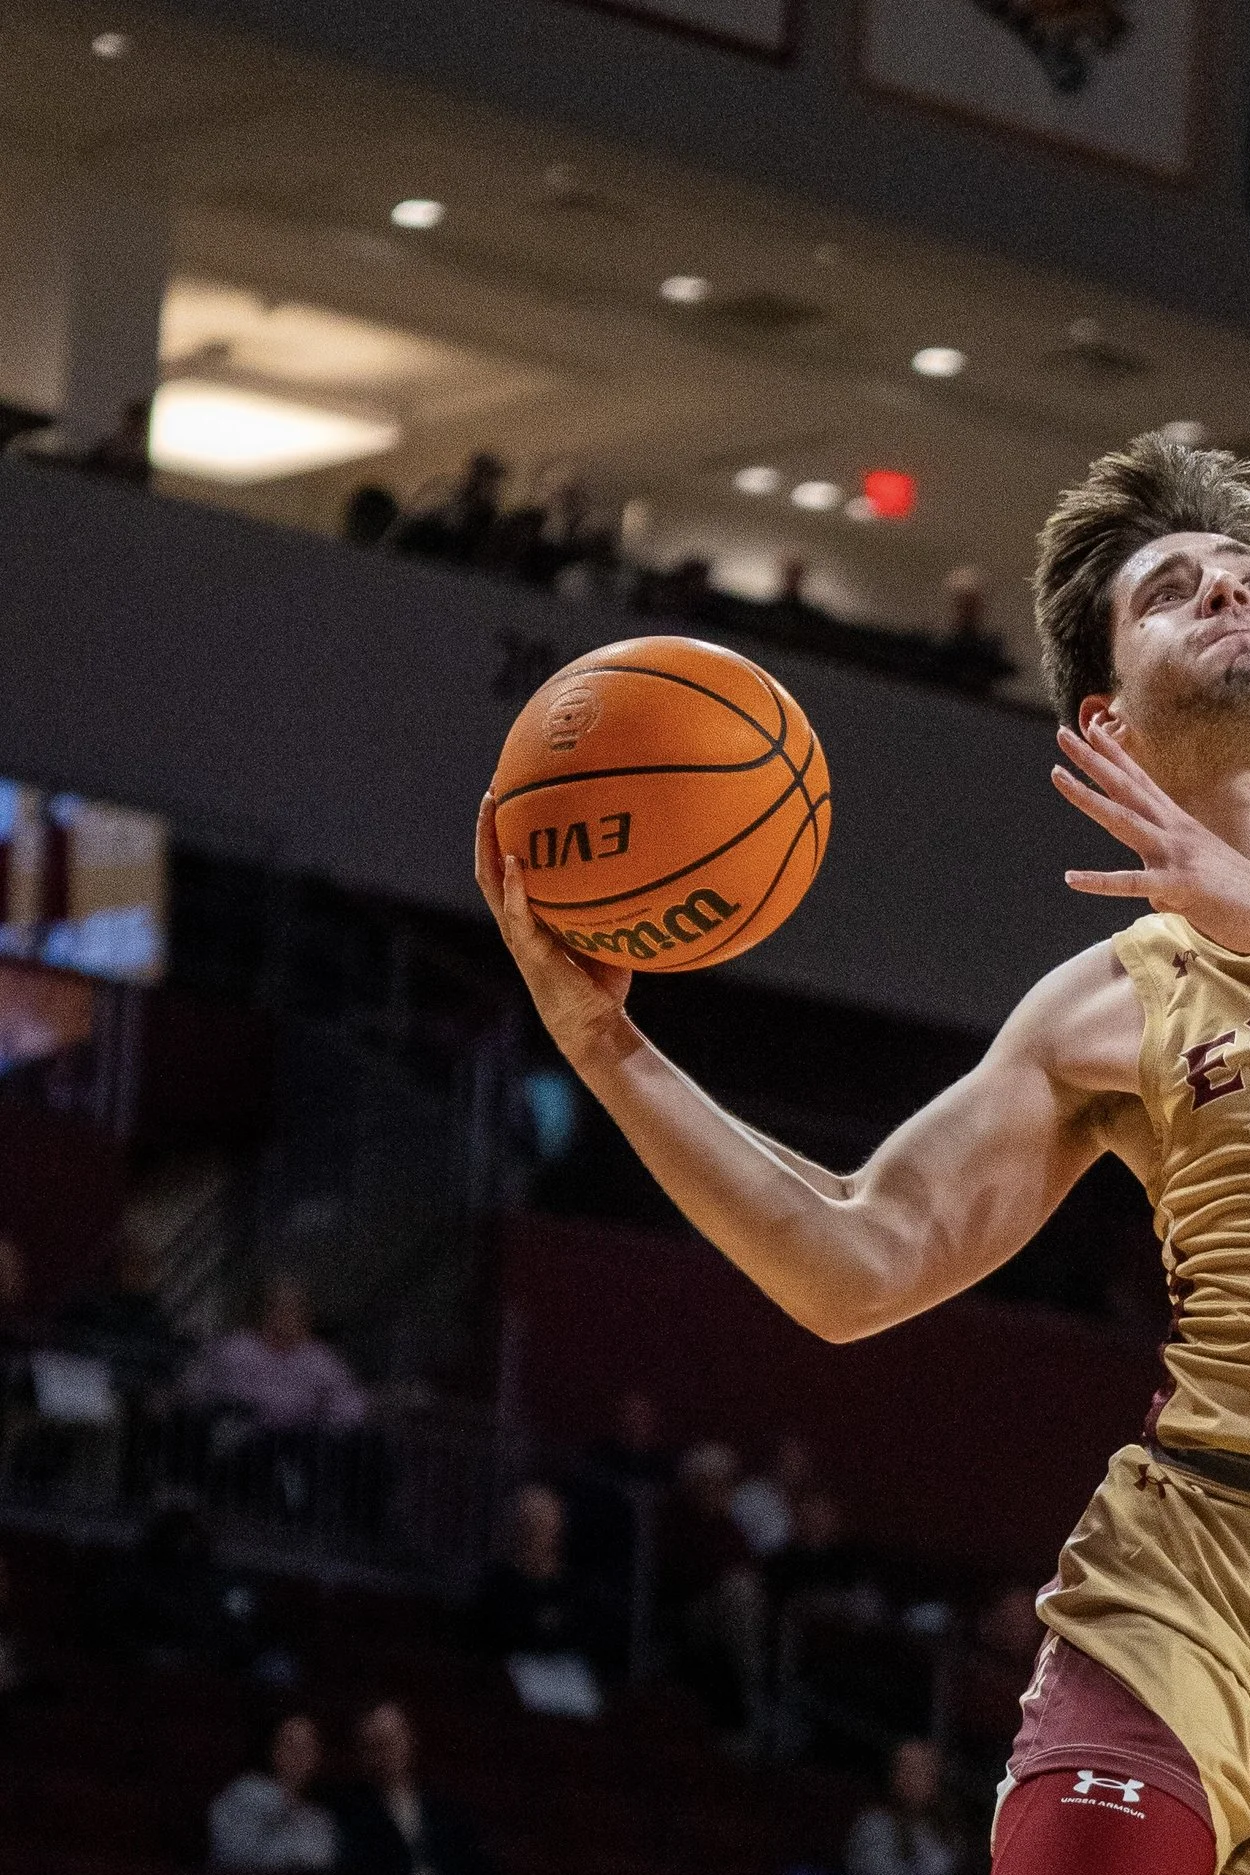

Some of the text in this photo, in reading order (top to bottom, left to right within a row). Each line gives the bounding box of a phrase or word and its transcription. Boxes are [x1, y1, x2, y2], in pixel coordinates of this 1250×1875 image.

[553, 888, 741, 960] Wilso
[1061, 1797, 1144, 1818] UNDER ARMOUR
